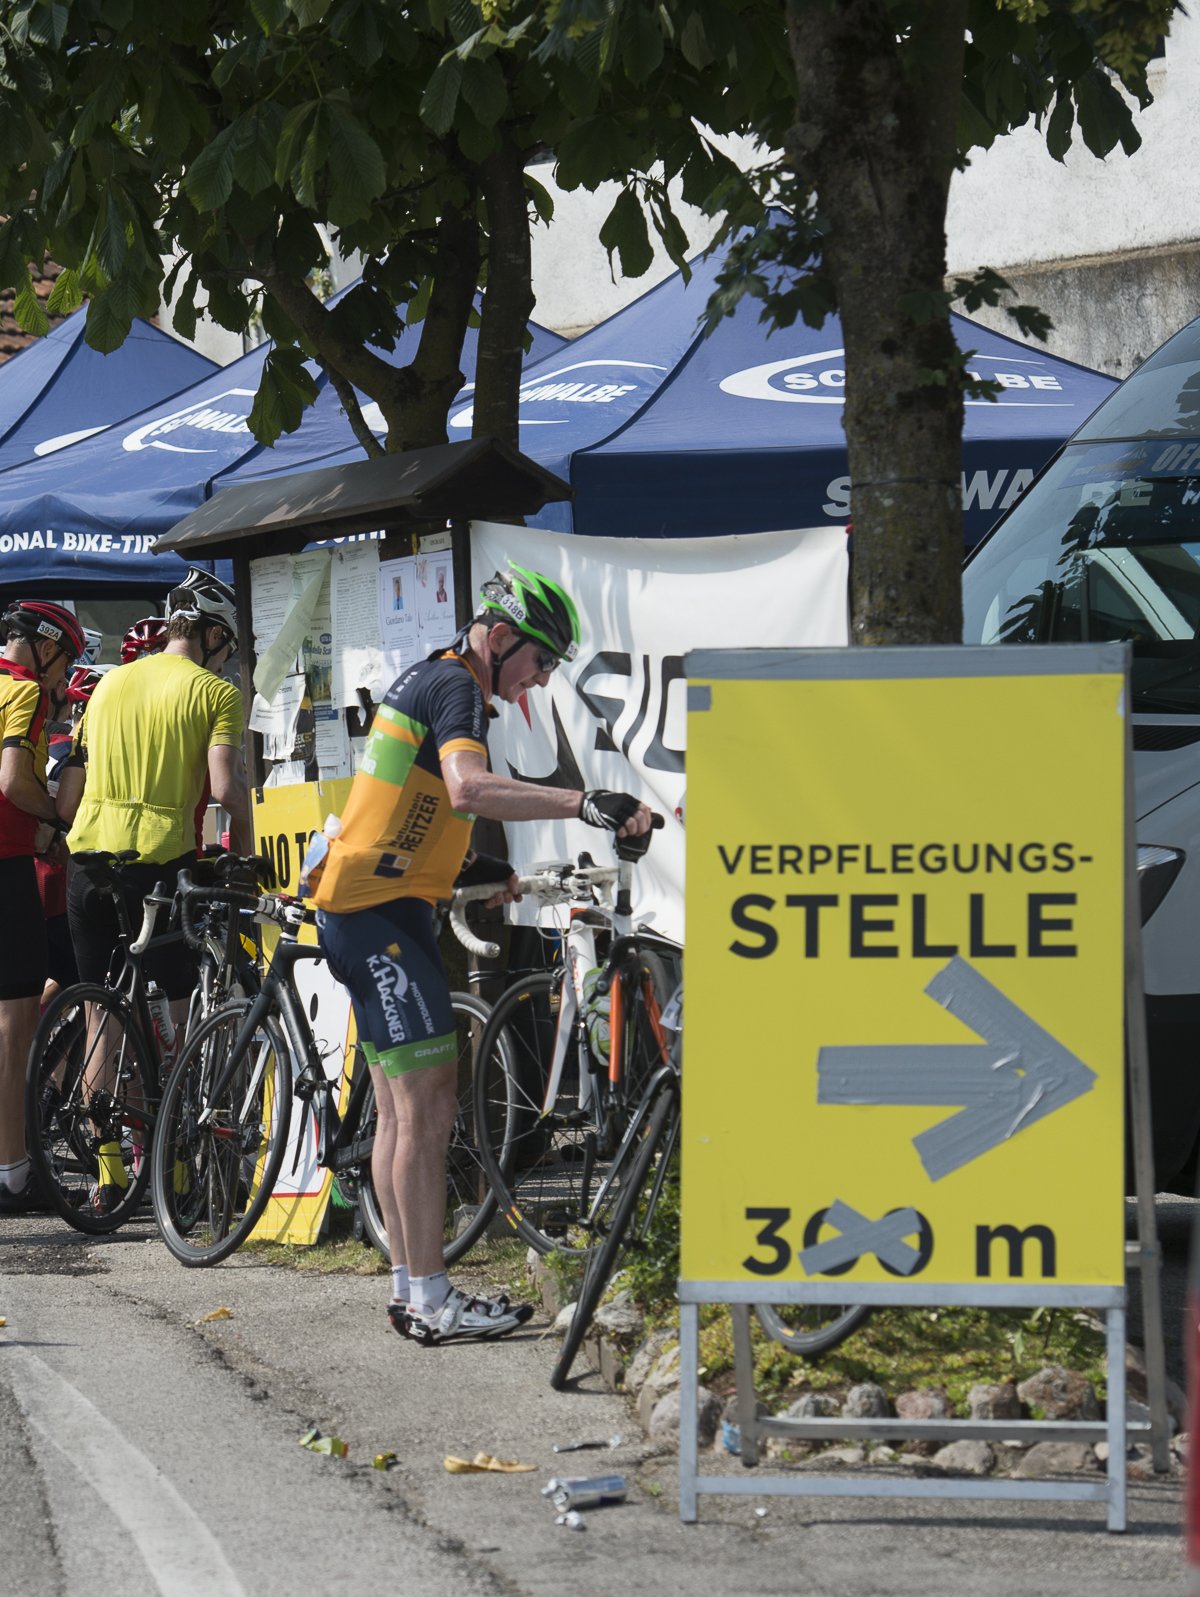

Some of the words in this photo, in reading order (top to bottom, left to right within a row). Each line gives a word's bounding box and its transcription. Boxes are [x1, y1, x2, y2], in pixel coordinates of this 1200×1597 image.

[39, 624, 60, 640] 392A
[502, 597, 525, 620] 318B
[390, 792, 423, 848] Naturstein
[399, 794, 439, 853] REITZER
[260, 833, 290, 889] NO
[717, 843, 1093, 875] VERPFLEGUNGS-
[728, 893, 1078, 959] STELLE
[409, 981, 435, 1035] PHOTOVOLTAIK
[414, 1044, 450, 1058] CRAFT
[976, 1224, 1057, 1278] m
